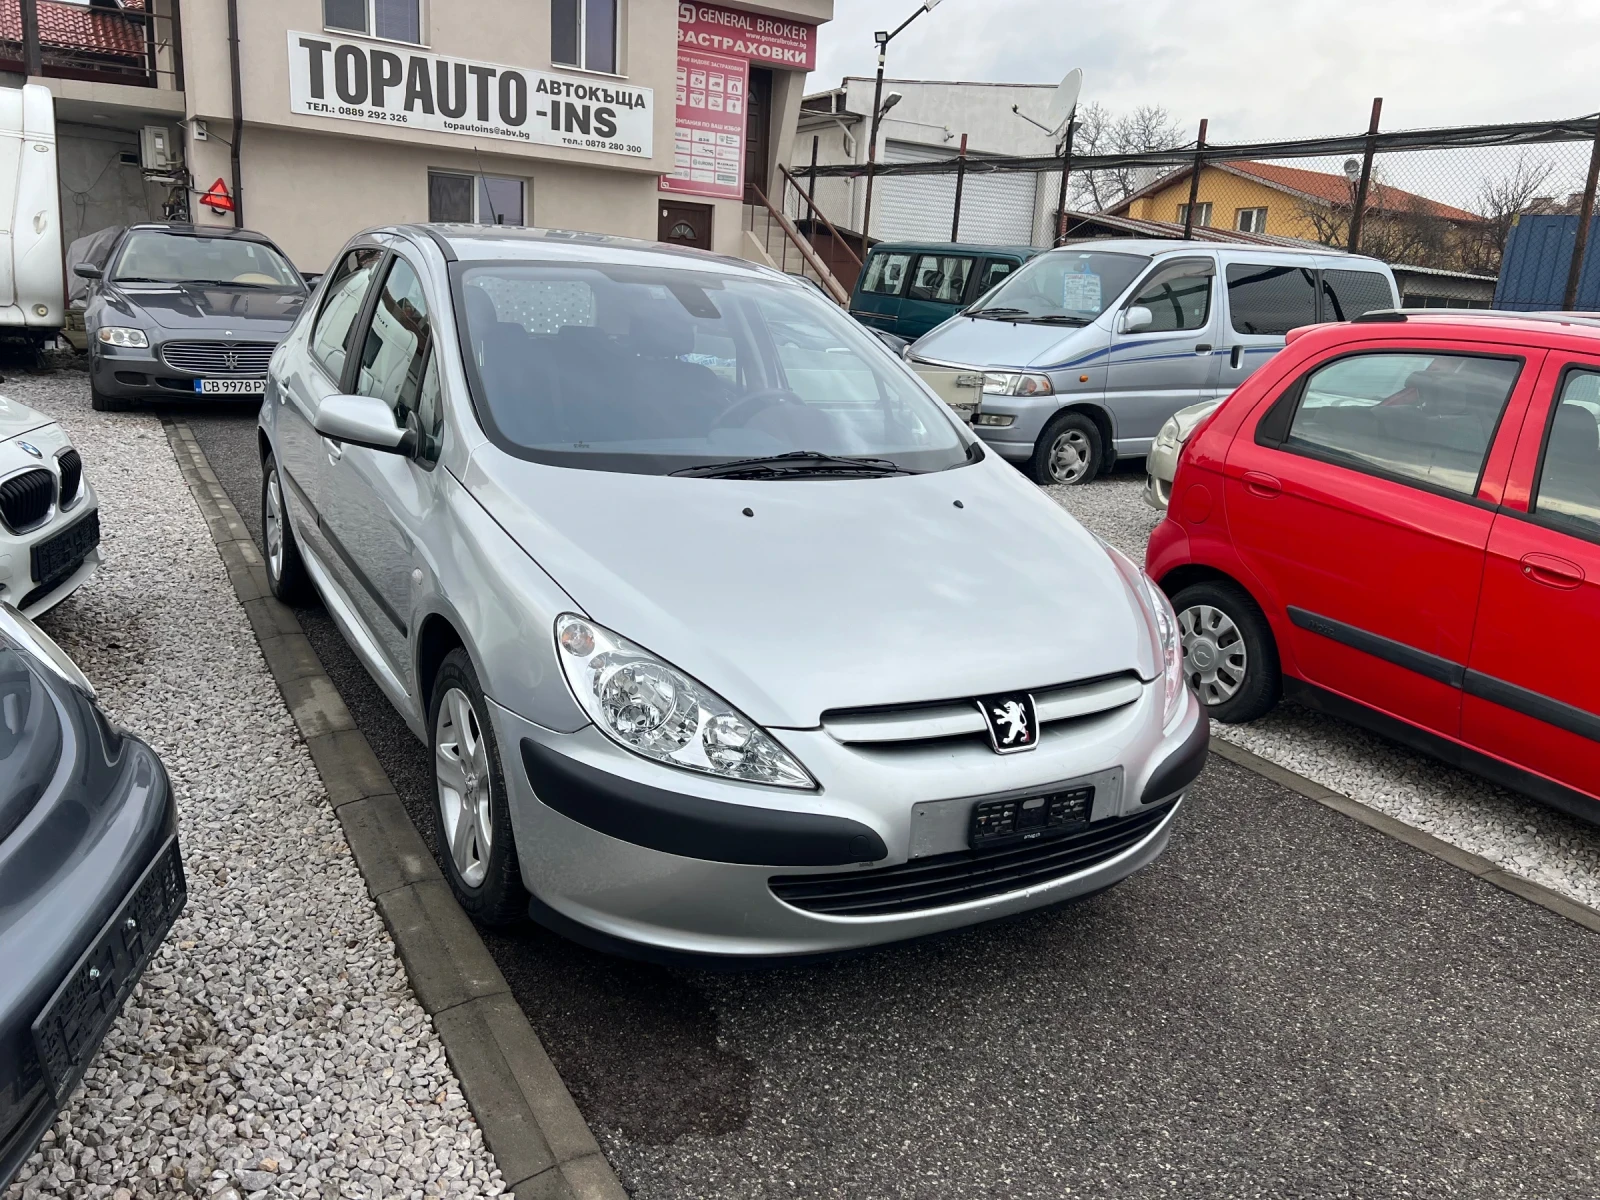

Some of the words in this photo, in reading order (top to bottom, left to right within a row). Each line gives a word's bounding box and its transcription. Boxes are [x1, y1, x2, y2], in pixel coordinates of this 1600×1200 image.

[698, 8, 753, 31] GENERAL
[756, 19, 808, 41] BROKER
[677, 29, 807, 64] ЗАСТРАХОВКИ
[745, 32, 807, 50] www.generalbroker.bg
[711, 61, 744, 72] ЗАСТРАХОВКИ
[299, 37, 527, 127] TOPAUTO
[535, 78, 646, 110] АВТОКЪЩА
[305, 101, 335, 114] ТЕЛ.:
[338, 107, 364, 117] 0889
[367, 110, 387, 120] 292
[389, 113, 408, 123] 326
[536, 100, 618, 139] -INS
[443, 120, 530, 140] topautoins@abv.bg
[562, 136, 583, 146] тел.:
[585, 139, 606, 149] 0878
[608, 141, 624, 151] 280
[626, 144, 642, 153] 300
[203, 381, 220, 392] CB
[222, 381, 252, 392] 9978
